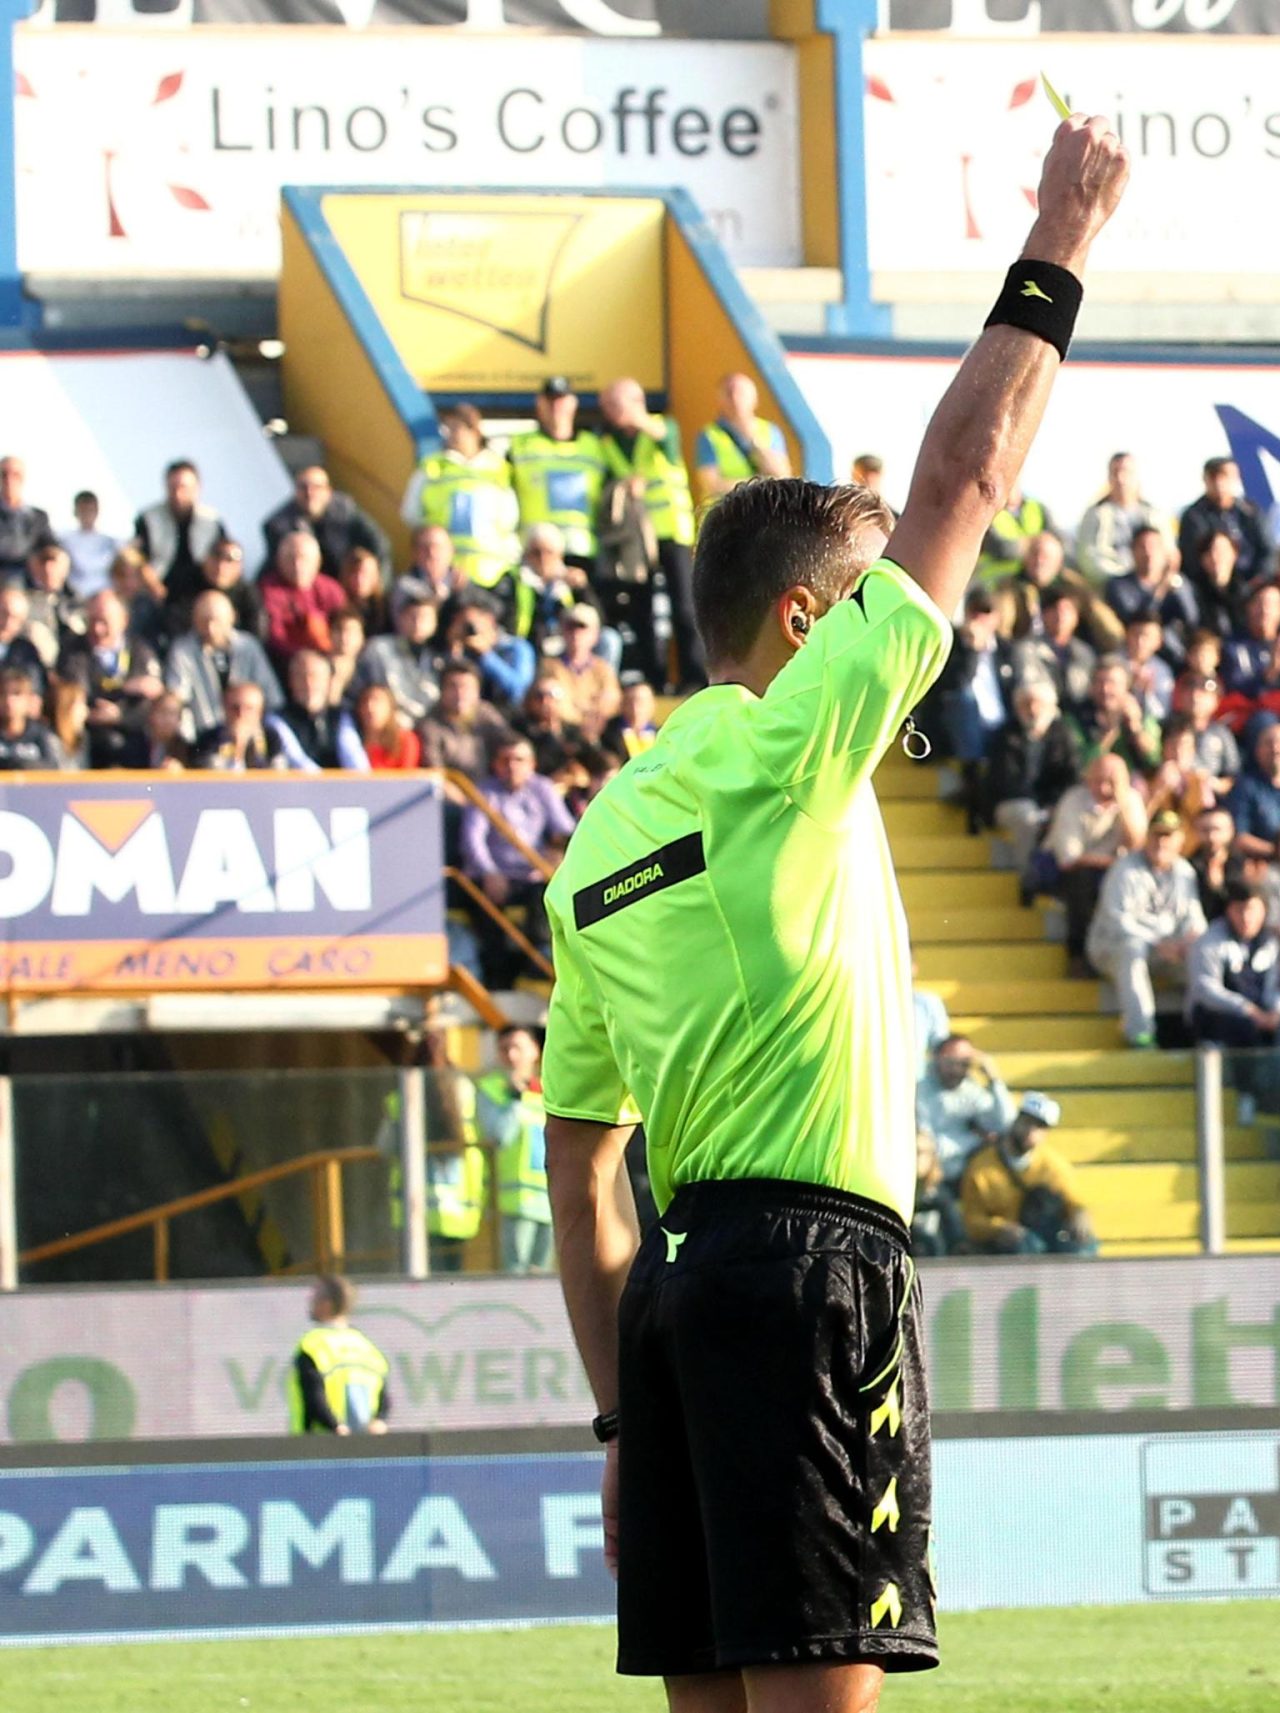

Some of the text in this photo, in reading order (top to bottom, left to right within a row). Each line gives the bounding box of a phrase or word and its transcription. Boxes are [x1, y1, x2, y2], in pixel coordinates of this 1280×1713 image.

[211, 86, 763, 159] Lino's Coffee
[603, 862, 664, 906] DIADORA
[116, 948, 237, 979] MENO
[268, 946, 375, 978] CARO
